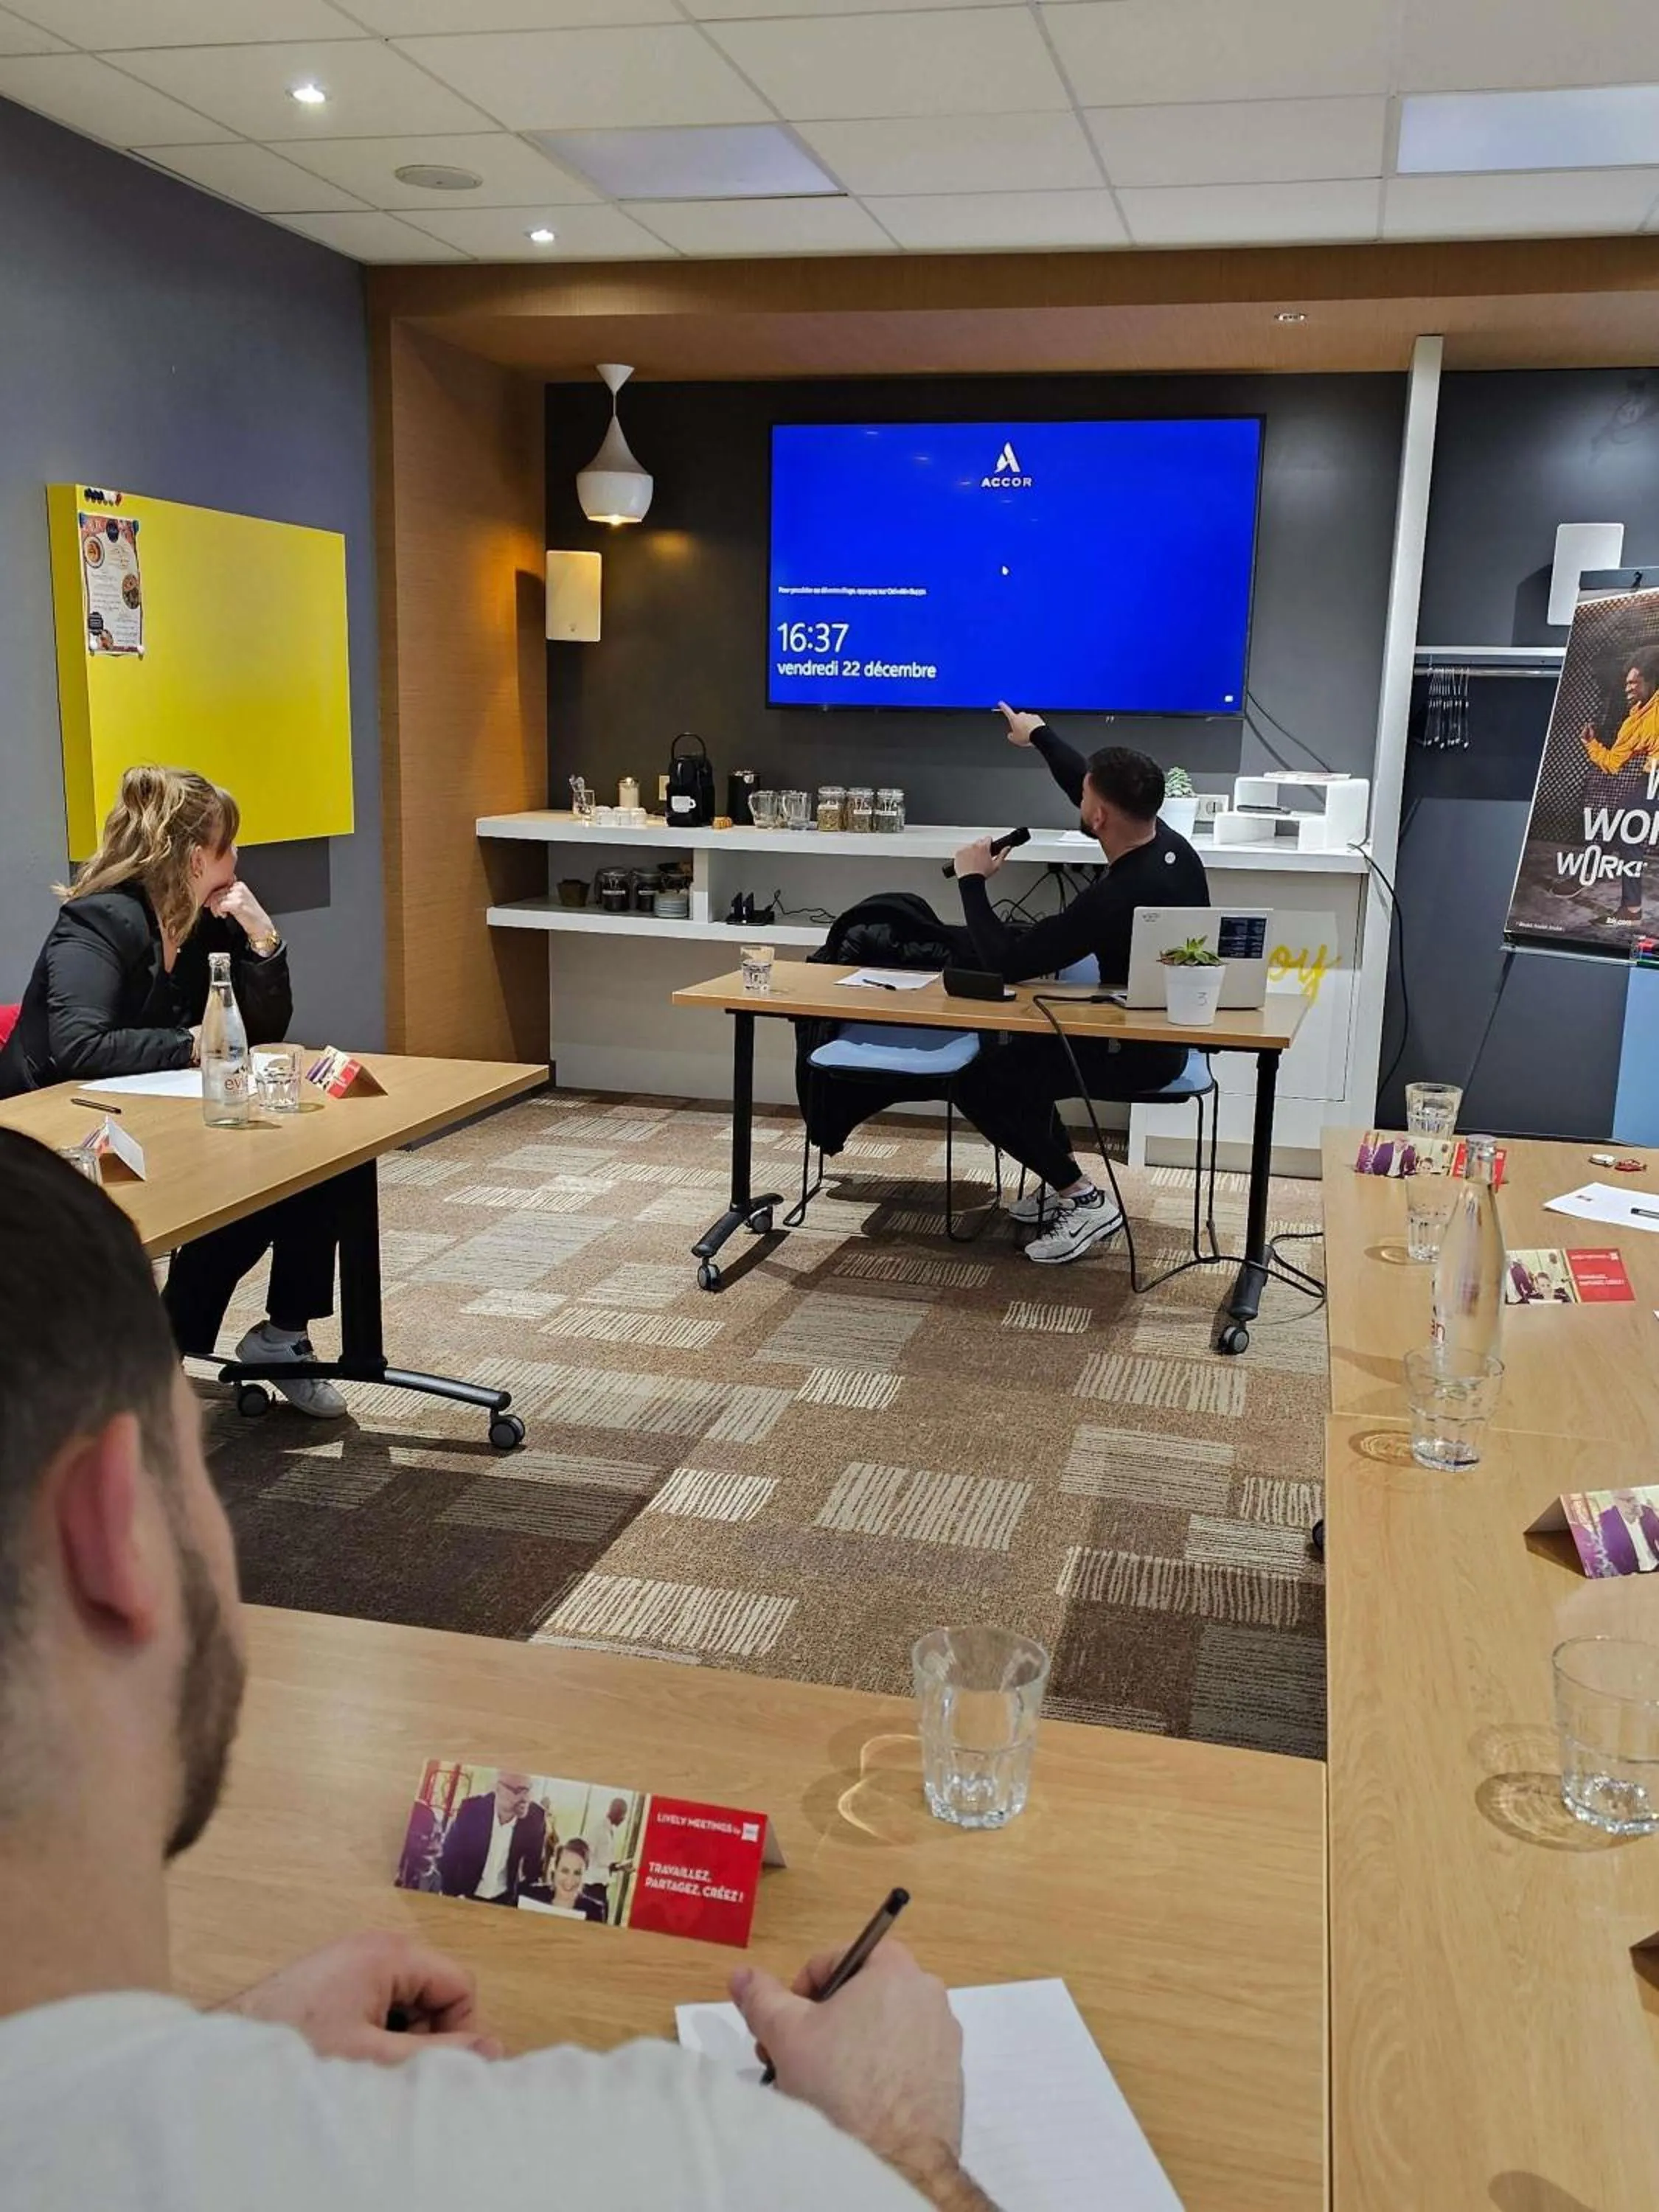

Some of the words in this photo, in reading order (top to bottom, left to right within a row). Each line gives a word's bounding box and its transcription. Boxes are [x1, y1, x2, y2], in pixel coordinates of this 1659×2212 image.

[981, 477, 1032, 487] ACCOR
[777, 622, 849, 653] 16:37
[777, 659, 838, 676] vendredi
[842, 661, 860, 676] 22
[863, 661, 936, 678] décembre
[1557, 845, 1643, 886] WORK!
[657, 1812, 686, 1826] LIVELY
